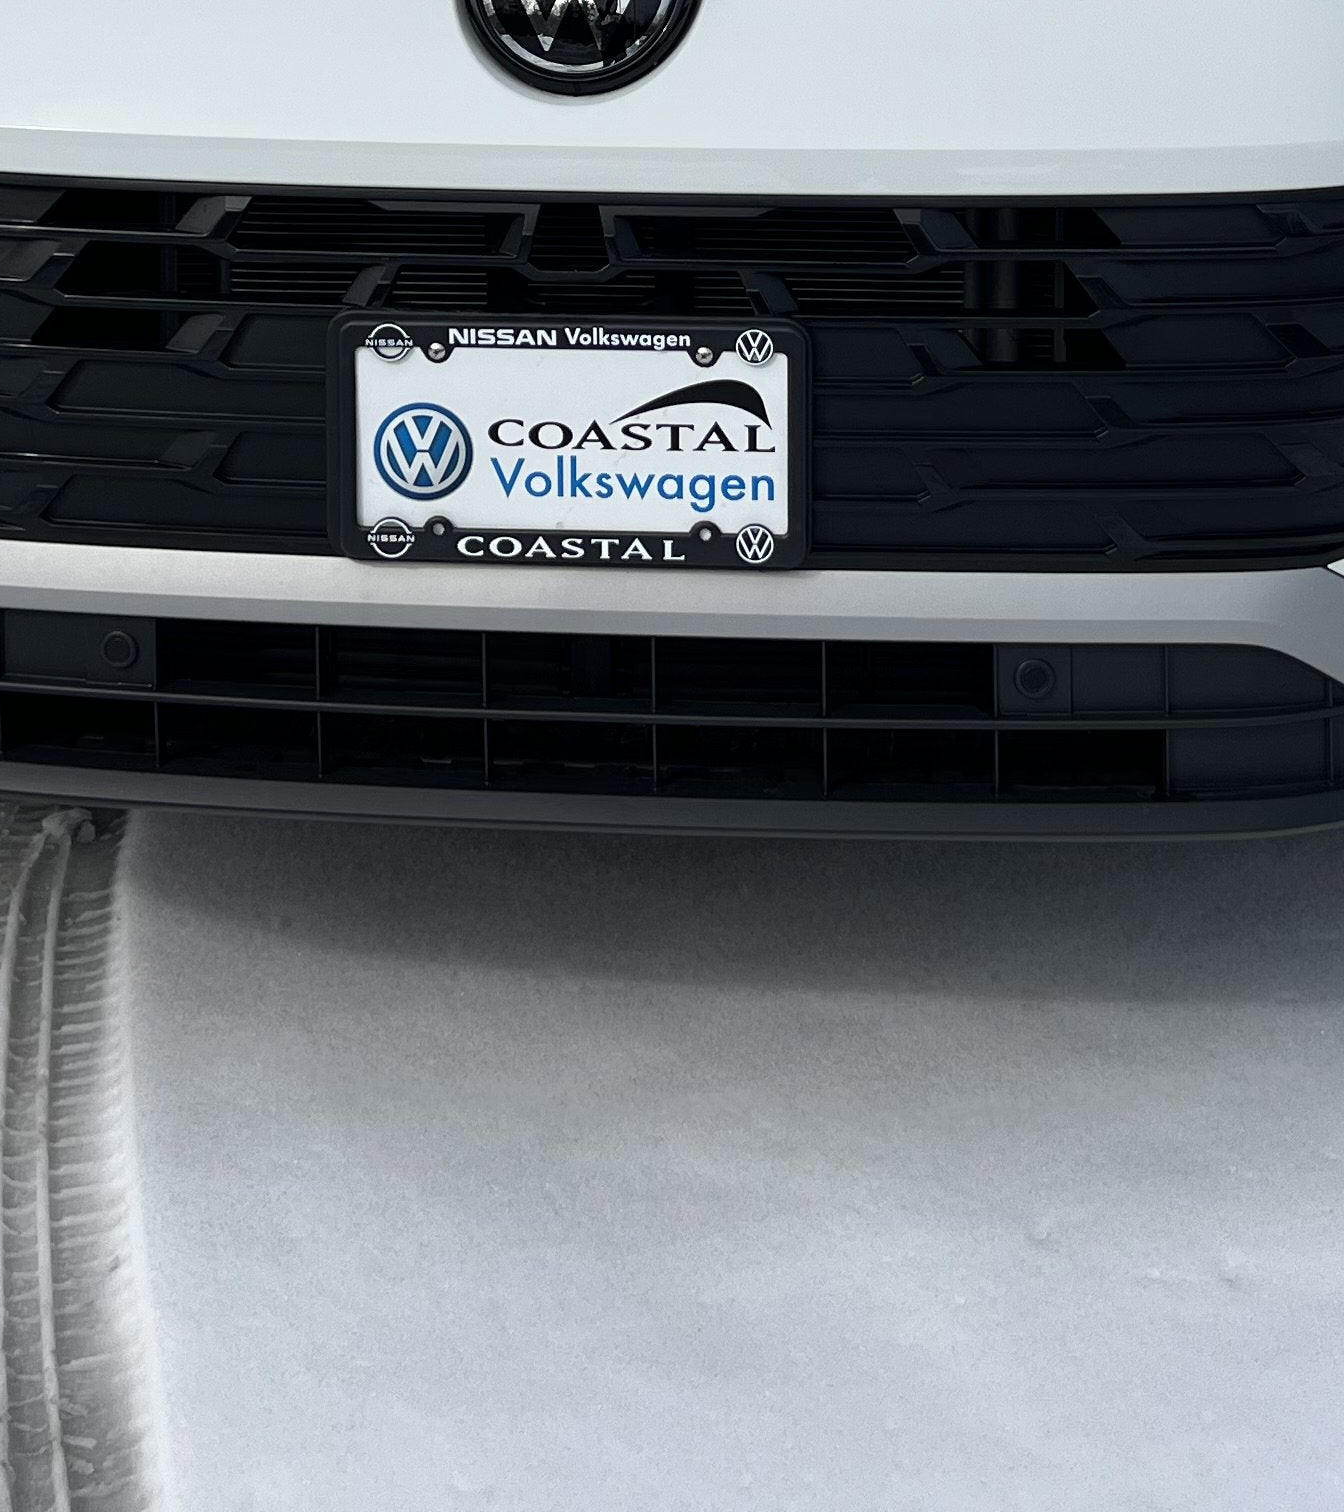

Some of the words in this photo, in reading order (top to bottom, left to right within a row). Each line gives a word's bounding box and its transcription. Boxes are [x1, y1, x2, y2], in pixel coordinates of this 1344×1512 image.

[365, 339, 413, 347] NISSAN
[448, 328, 557, 346] NISSAN
[564, 326, 691, 350] Volkswagen
[487, 418, 776, 453] COASTAL
[490, 454, 775, 513] Volkswagen
[367, 534, 415, 542] NISSAN
[457, 535, 686, 562] COASTAL
